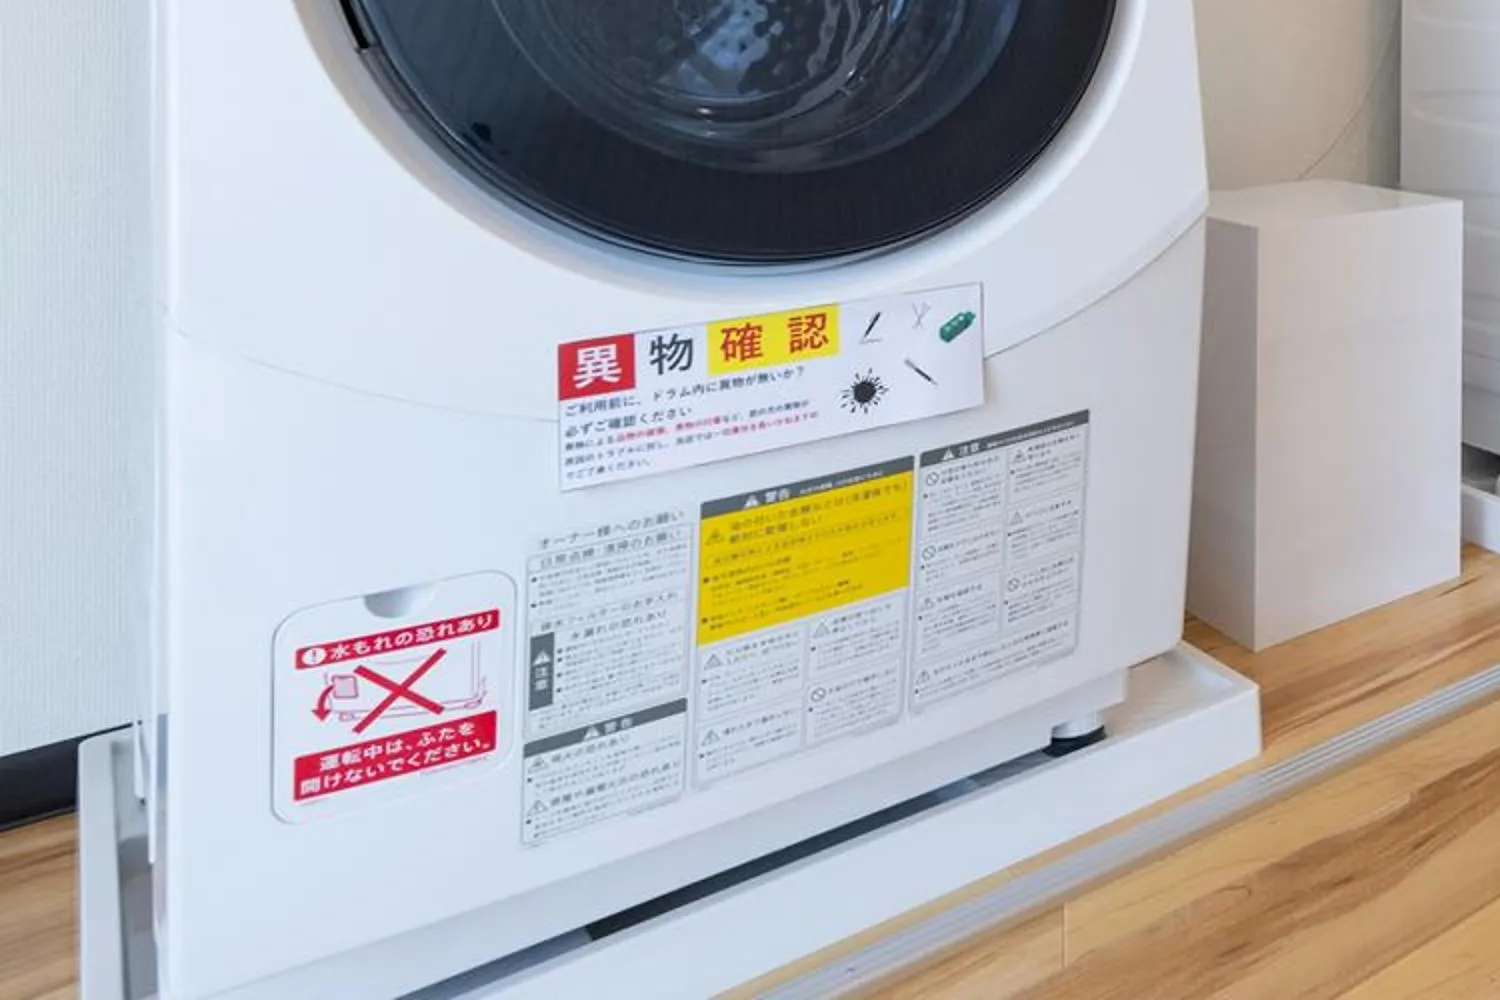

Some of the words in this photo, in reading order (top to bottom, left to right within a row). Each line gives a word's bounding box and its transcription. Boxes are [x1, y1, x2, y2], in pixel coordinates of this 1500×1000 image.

[573, 312, 829, 389] 異物確認
[330, 614, 493, 662] 水もれの恐れあり
[300, 740, 490, 794] 開けないでください。
[319, 722, 476, 772] 運転中は、ふたを
